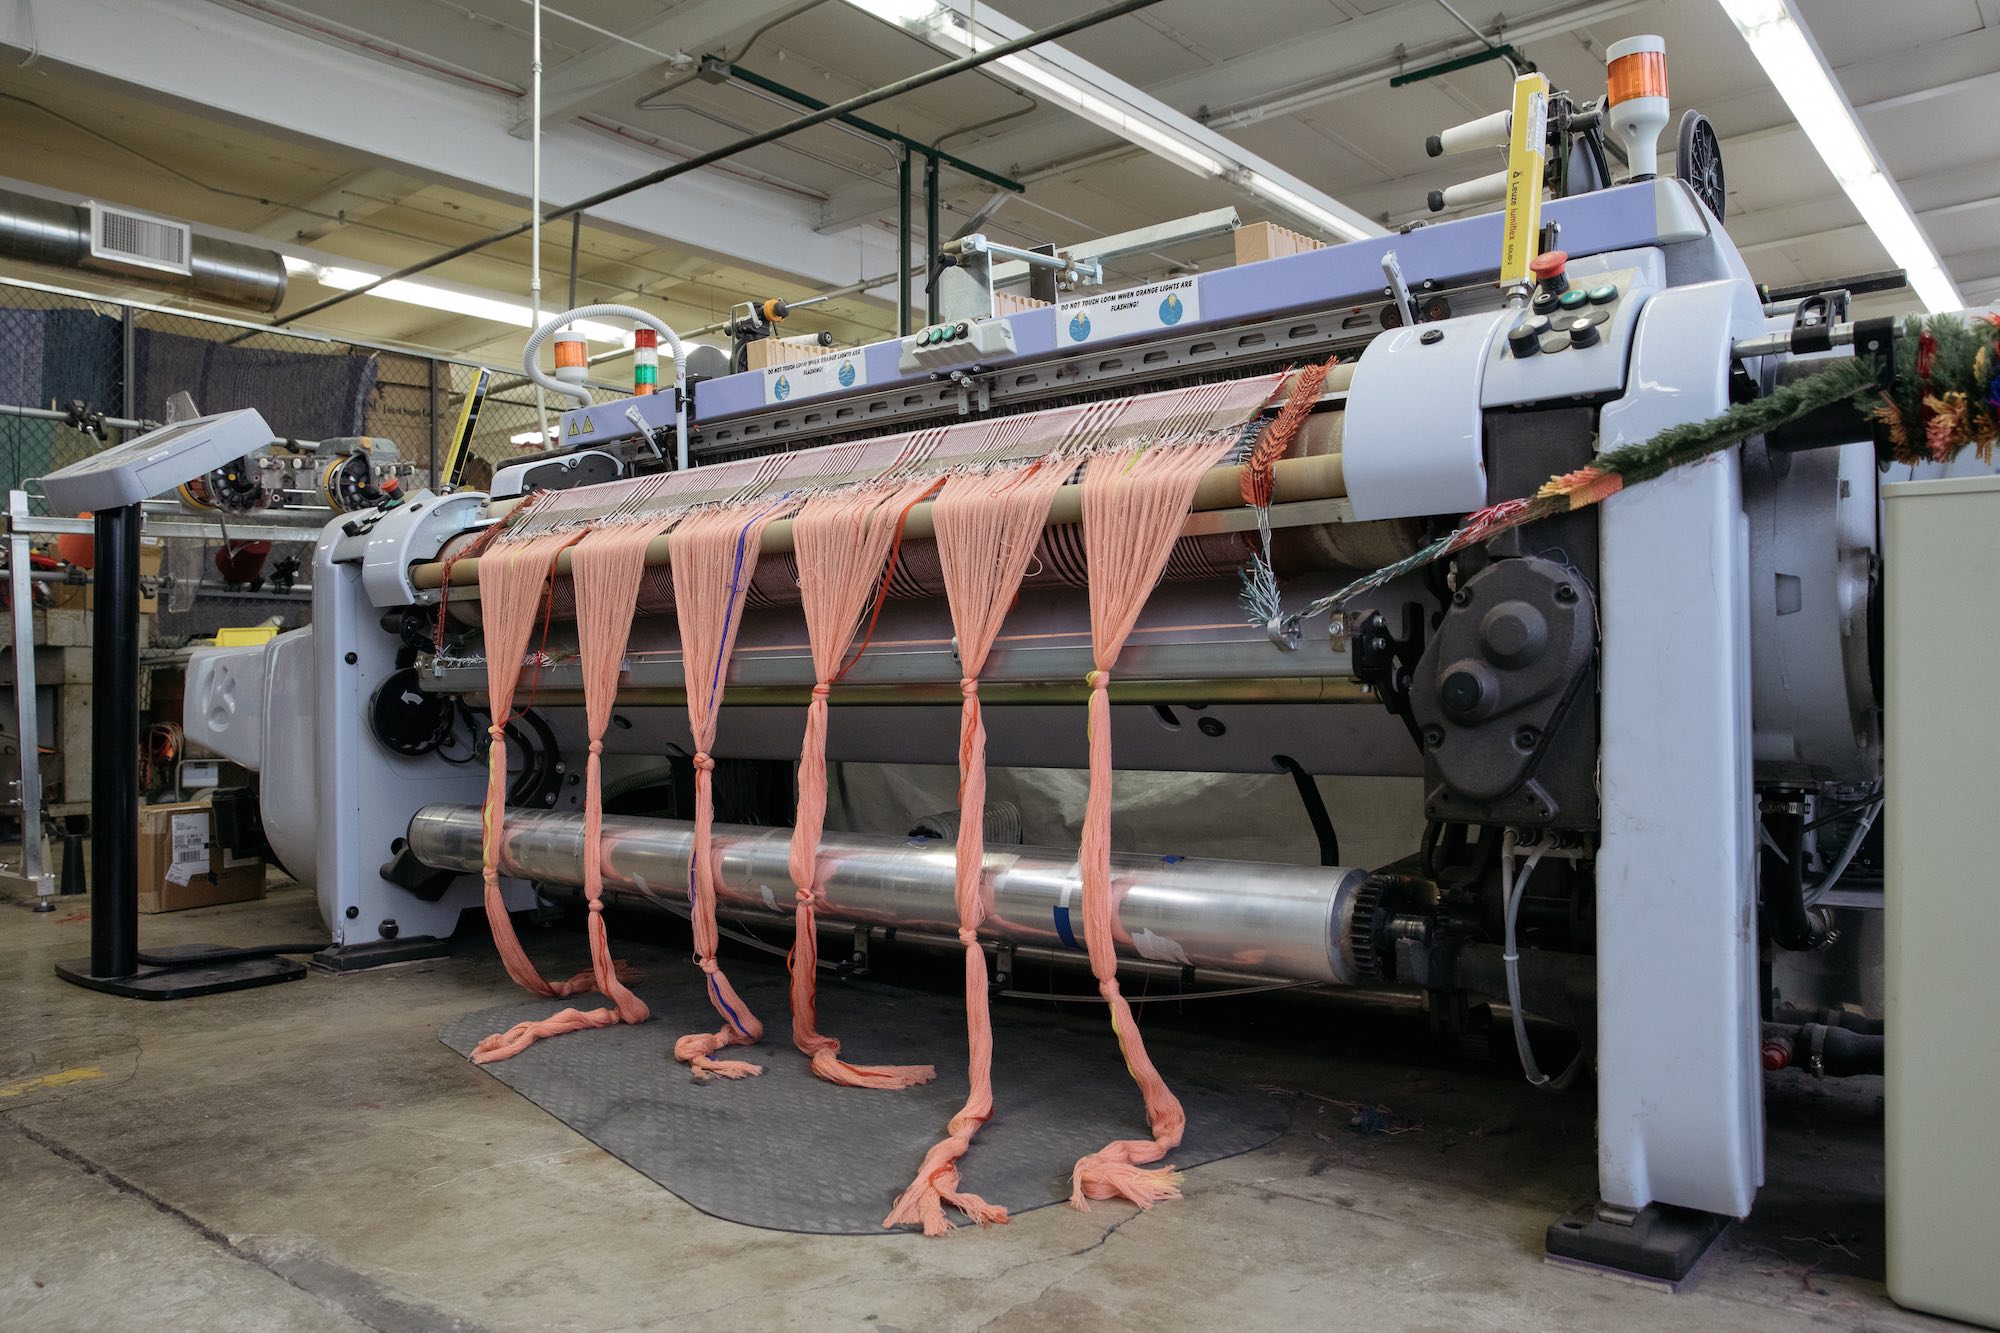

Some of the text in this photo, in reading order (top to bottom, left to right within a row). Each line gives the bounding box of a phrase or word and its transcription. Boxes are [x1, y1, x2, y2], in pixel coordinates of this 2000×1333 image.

[1511, 182, 1519, 206] Leuze
[1509, 208, 1518, 240] lumiflex
[1070, 301, 1081, 309] NOT
[1082, 299, 1098, 307] TOUCH
[1100, 295, 1117, 304] LOOM
[1118, 292, 1134, 300] WHEN
[1136, 287, 1158, 296] ORANGE
[1160, 283, 1180, 292] LIGHTS
[1180, 280, 1193, 288] ARE
[1111, 301, 1139, 312] FLASHING!
